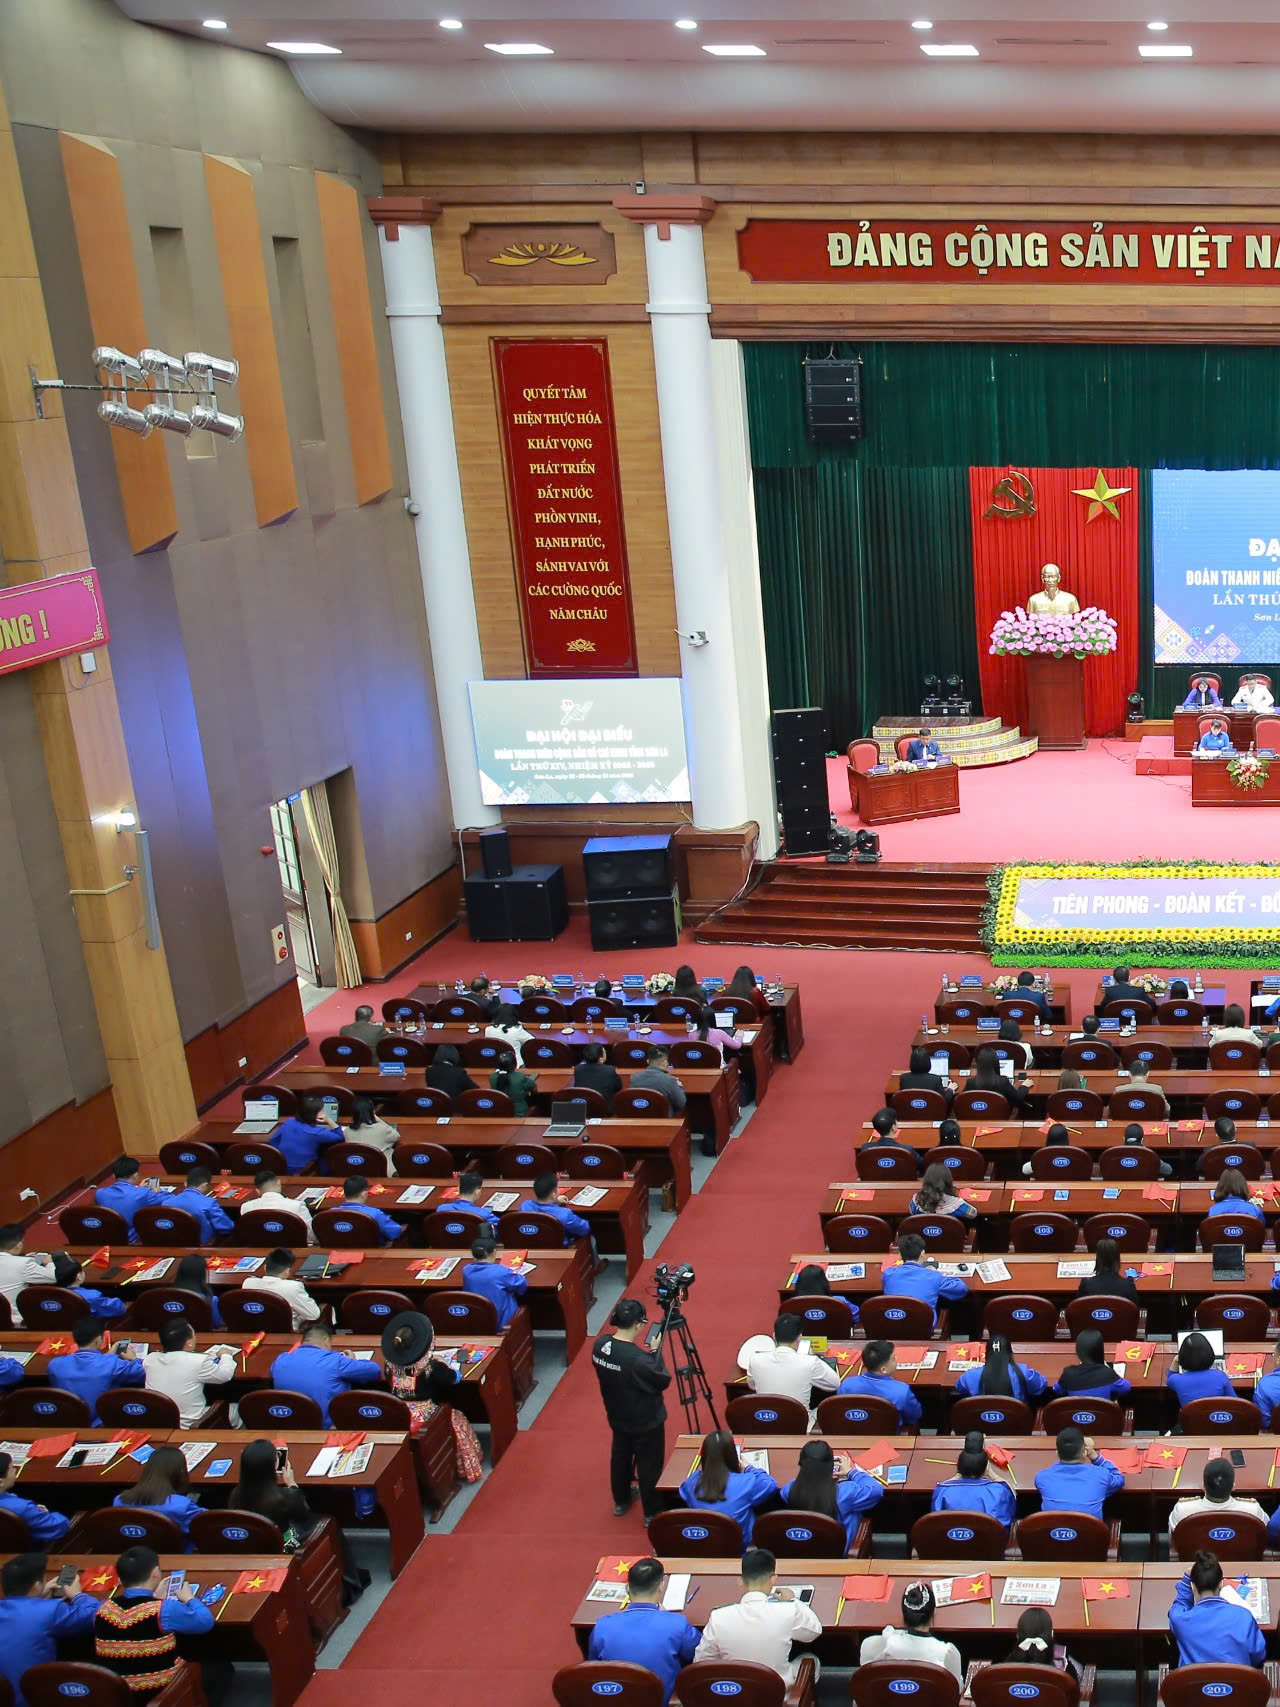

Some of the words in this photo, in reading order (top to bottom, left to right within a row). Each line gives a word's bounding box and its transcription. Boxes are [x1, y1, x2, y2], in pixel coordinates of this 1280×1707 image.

[827, 221, 933, 267] ĐẢNG
[944, 224, 1049, 275] CỘNG
[1060, 221, 1139, 268] SẢN
[1152, 225, 1233, 276] VIỆT
[523, 383, 561, 402] QUYẾT
[561, 384, 587, 399] TÂM
[513, 410, 542, 427] HIỆN
[543, 411, 576, 427] THỰC
[576, 409, 602, 424] HÓA
[527, 435, 559, 450] KHÁT
[559, 438, 593, 452] VỌNG
[529, 460, 560, 474] PHÁT
[560, 458, 596, 474] TRIỂN
[537, 483, 561, 499] ĐẤT
[561, 484, 594, 499] NƯỚC
[534, 507, 567, 523] PHỒN
[567, 512, 601, 525] VINH,
[534, 537, 571, 550] HẠNH
[570, 534, 606, 549] PHÚC,
[535, 558, 568, 572] SÁNH
[567, 561, 588, 572] VAI
[589, 558, 610, 572] VỚI
[1185, 567, 1219, 586] ĐOÀN
[1221, 570, 1261, 586] THANH
[528, 582, 551, 596] CÁC
[551, 581, 590, 596] CƯỜNG
[591, 580, 623, 598] QUỐC
[1212, 589, 1244, 606] LẦN
[576, 606, 608, 620] CHÂU
[1053, 892, 1089, 914] TIÊN
[1092, 895, 1149, 914] PHONG
[1164, 892, 1210, 913] ĐOÀN
[1215, 889, 1246, 913] KẾT
[808, 1311, 824, 1319] 125
[1015, 1311, 1031, 1319] 127
[758, 1412, 775, 1420] 149
[984, 1413, 1002, 1421] 151
[226, 1529, 245, 1538] 172
[686, 1528, 705, 1537] 173
[951, 1530, 971, 1539] 175
[1212, 1530, 1232, 1538] 177
[63, 1685, 85, 1694] 196
[596, 1684, 619, 1693] 197
[715, 1683, 738, 1693] 198
[893, 1682, 916, 1692] 199
[1013, 1686, 1035, 1696] 200
[1206, 1685, 1229, 1694] 201
